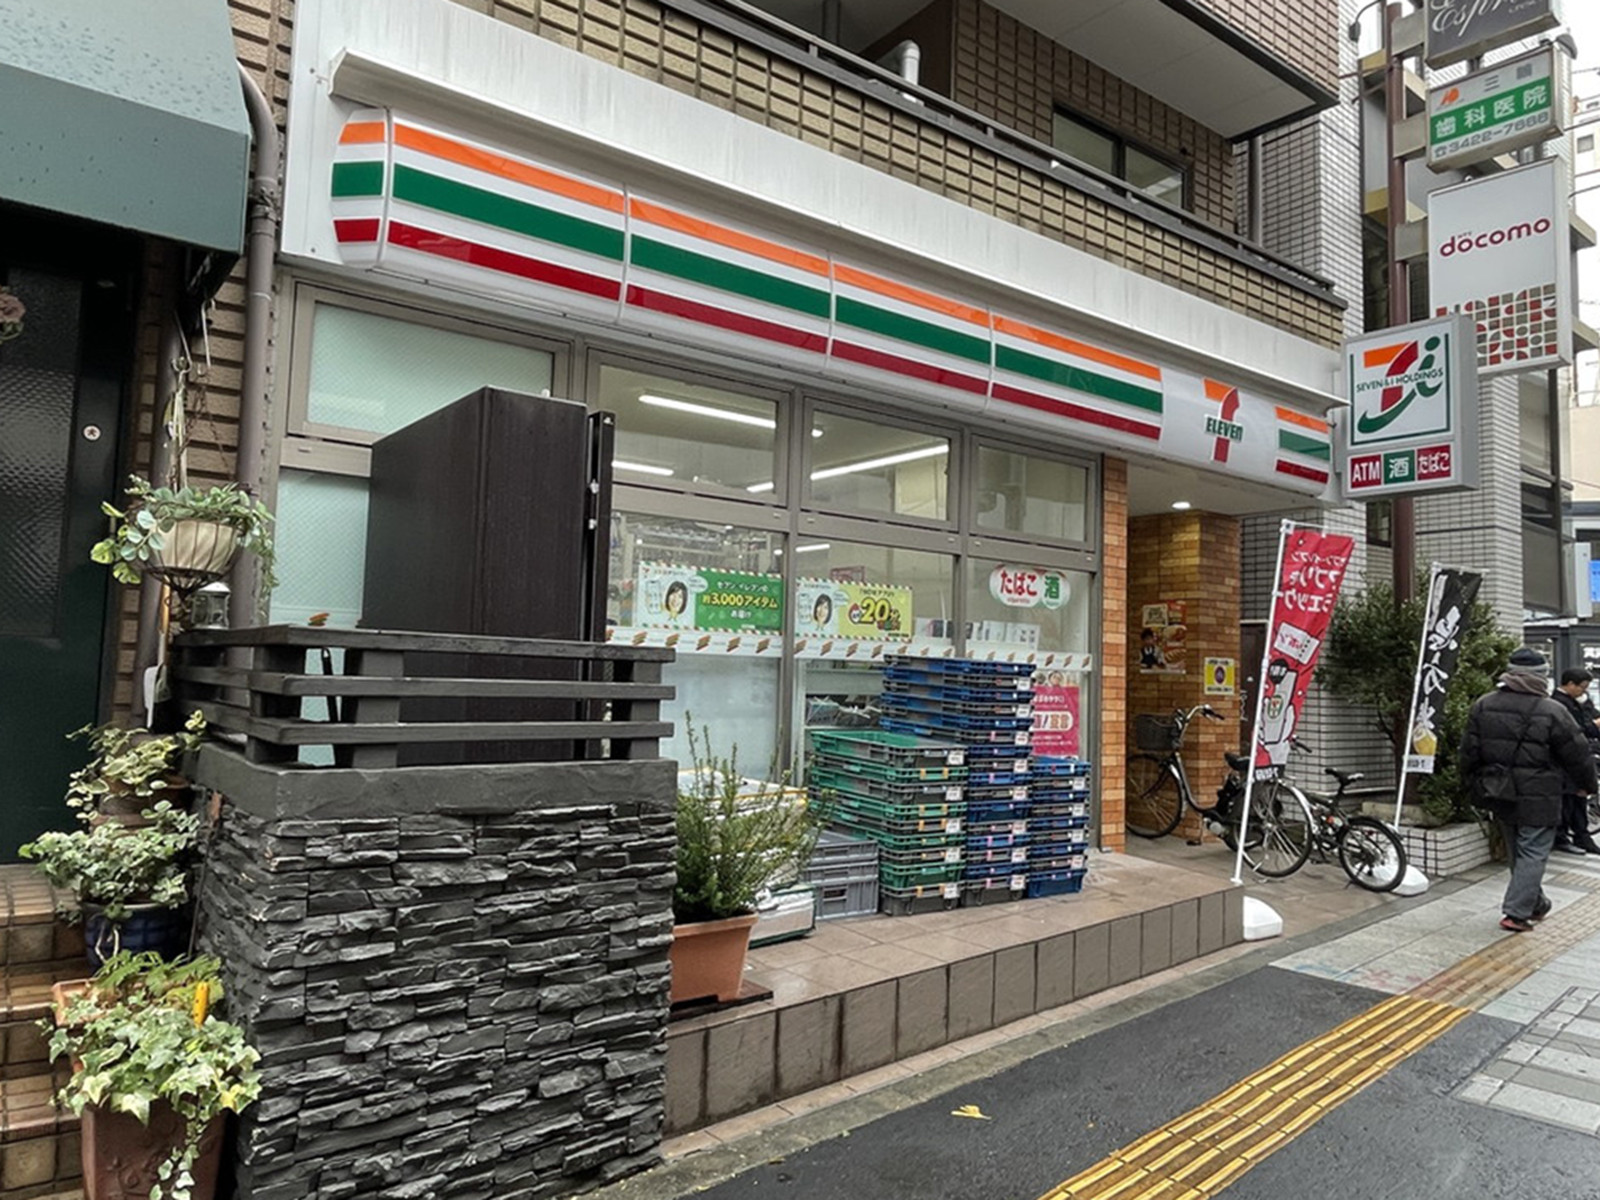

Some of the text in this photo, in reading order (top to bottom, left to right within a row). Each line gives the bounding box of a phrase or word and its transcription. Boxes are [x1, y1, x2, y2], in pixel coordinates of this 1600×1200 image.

[1435, 84, 1548, 138] 歯科医院
[1440, 217, 1551, 258] docomo
[1352, 452, 1450, 483] ATM 酒 たばこ
[1000, 569, 1061, 599] たばこ 酒
